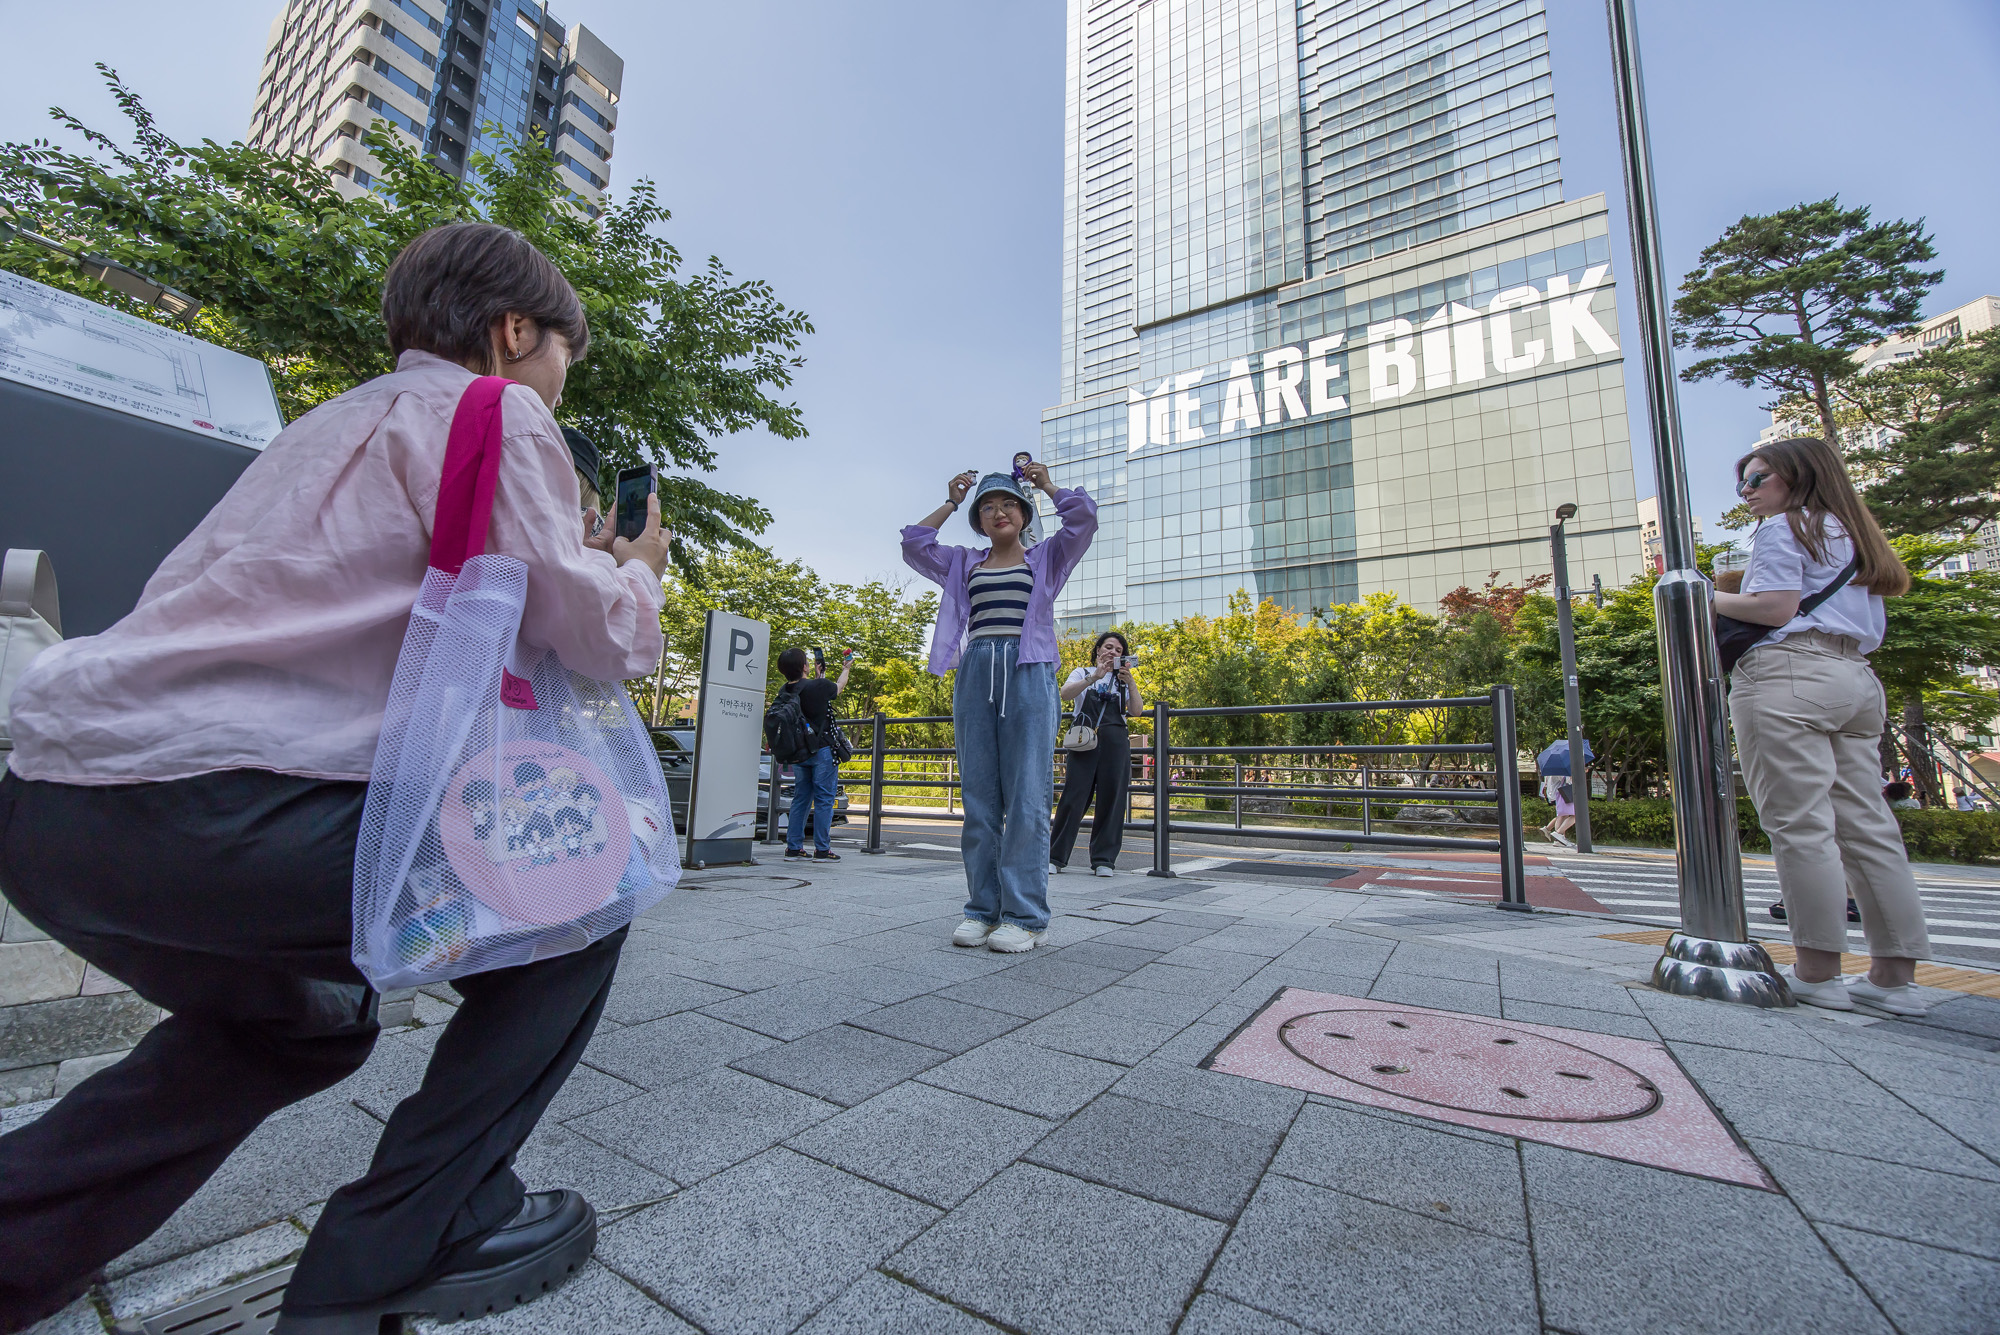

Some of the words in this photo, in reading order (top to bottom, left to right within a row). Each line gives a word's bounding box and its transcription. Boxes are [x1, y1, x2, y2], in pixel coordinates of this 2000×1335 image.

[89, 310, 106, 319] for
[111, 319, 166, 339] everyone
[1220, 334, 1348, 434] ARE
[218, 426, 242, 438] LG
[728, 627, 754, 672] P
[719, 697, 754, 712] 지하주차장
[721, 709, 738, 719] Parking
[739, 711, 749, 719] Area
